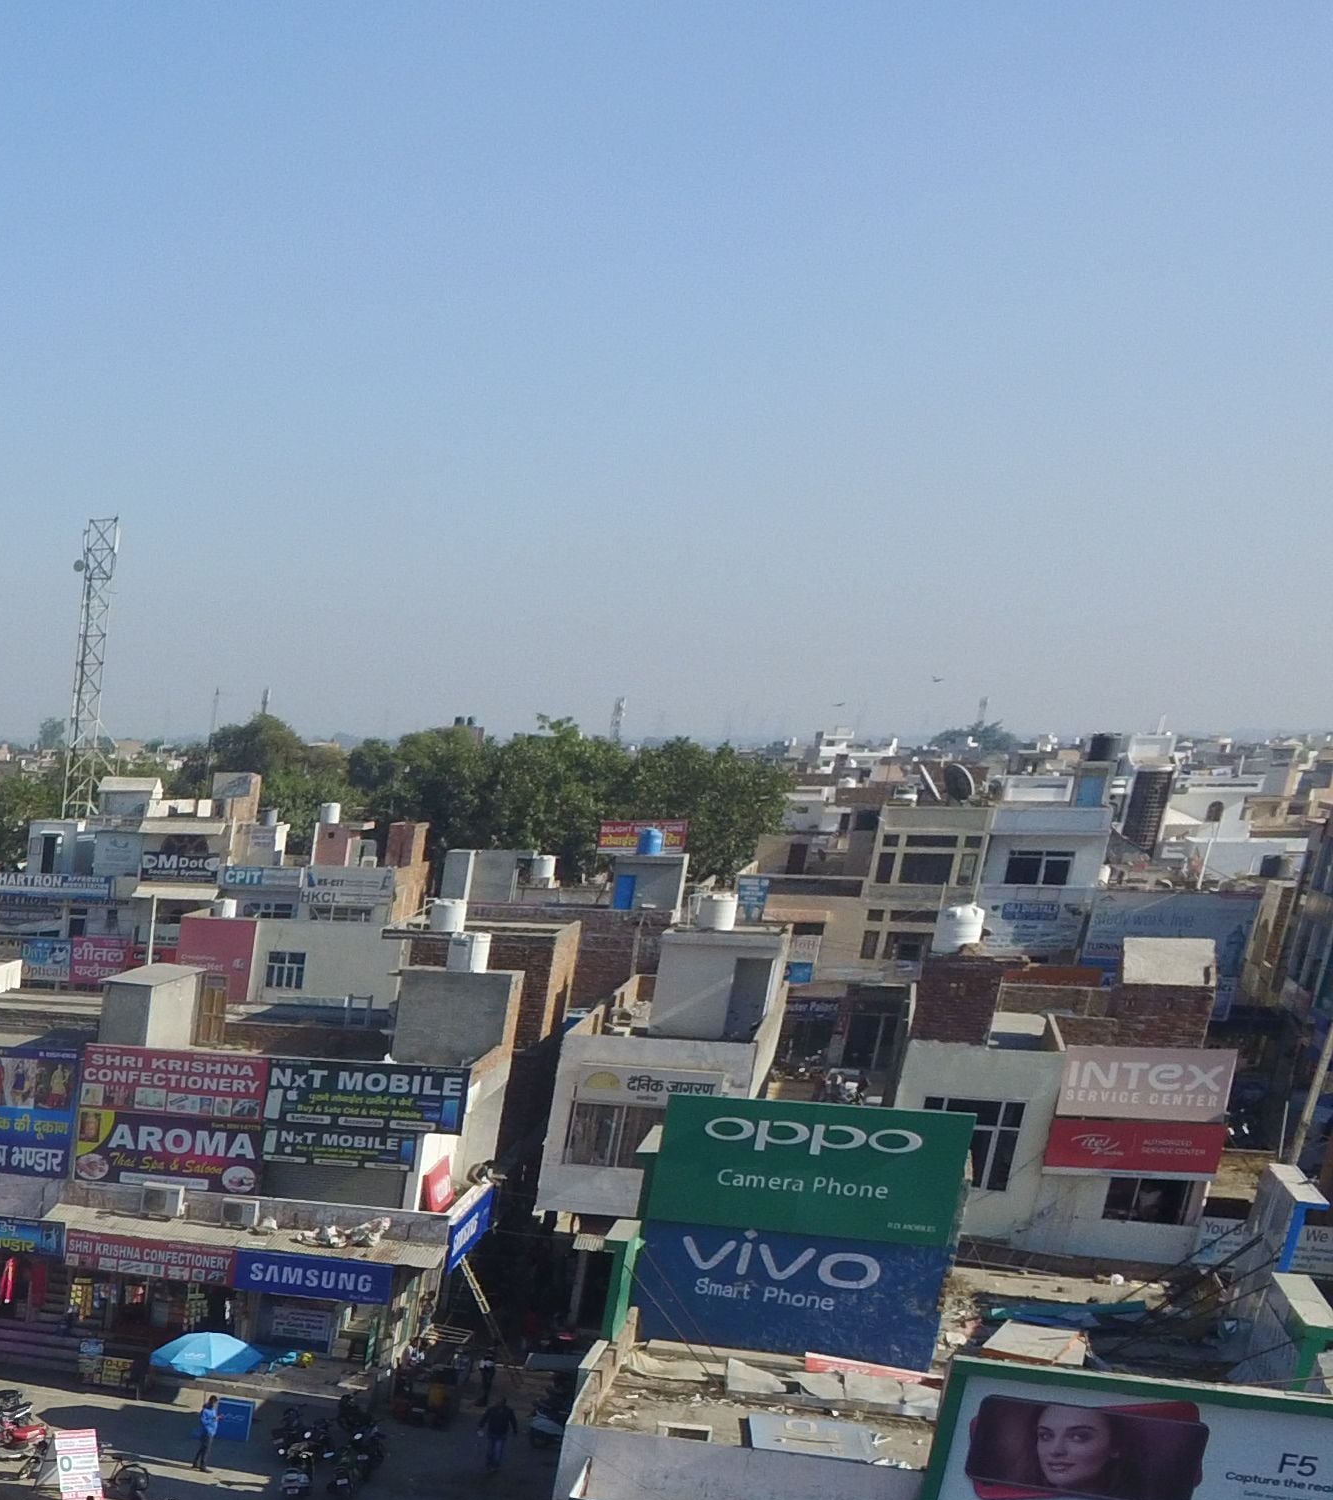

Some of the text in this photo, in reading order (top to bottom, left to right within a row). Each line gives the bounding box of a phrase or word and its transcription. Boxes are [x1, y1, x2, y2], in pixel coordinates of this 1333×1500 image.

[225, 869, 262, 885] CPIT
[91, 1054, 143, 1068] SHRI
[151, 1058, 254, 1077] KRISHNA
[84, 1068, 260, 1094] CONFECTIONERY
[270, 1068, 463, 1097] NxT MOBILE
[627, 1074, 715, 1095] दैनिक जागरण
[1065, 1089, 1218, 1108] SERVICE CENTER
[107, 1124, 256, 1160] AROMA
[322, 1134, 399, 1151] MOBILE
[139, 1157, 165, 1170] Spa
[717, 1168, 889, 1200] Camera Phone
[1306, 1229, 1329, 1243] We
[69, 1239, 231, 1270] SHRI KRISHNA CONFECTIONERY
[682, 1228, 881, 1289] vivo
[249, 1262, 373, 1292] SAMSUNG
[694, 1276, 836, 1312] Smart Phone
[1278, 1453, 1318, 1477] F5
[1226, 1471, 1281, 1486] Capture
[1284, 1478, 1306, 1489] the
